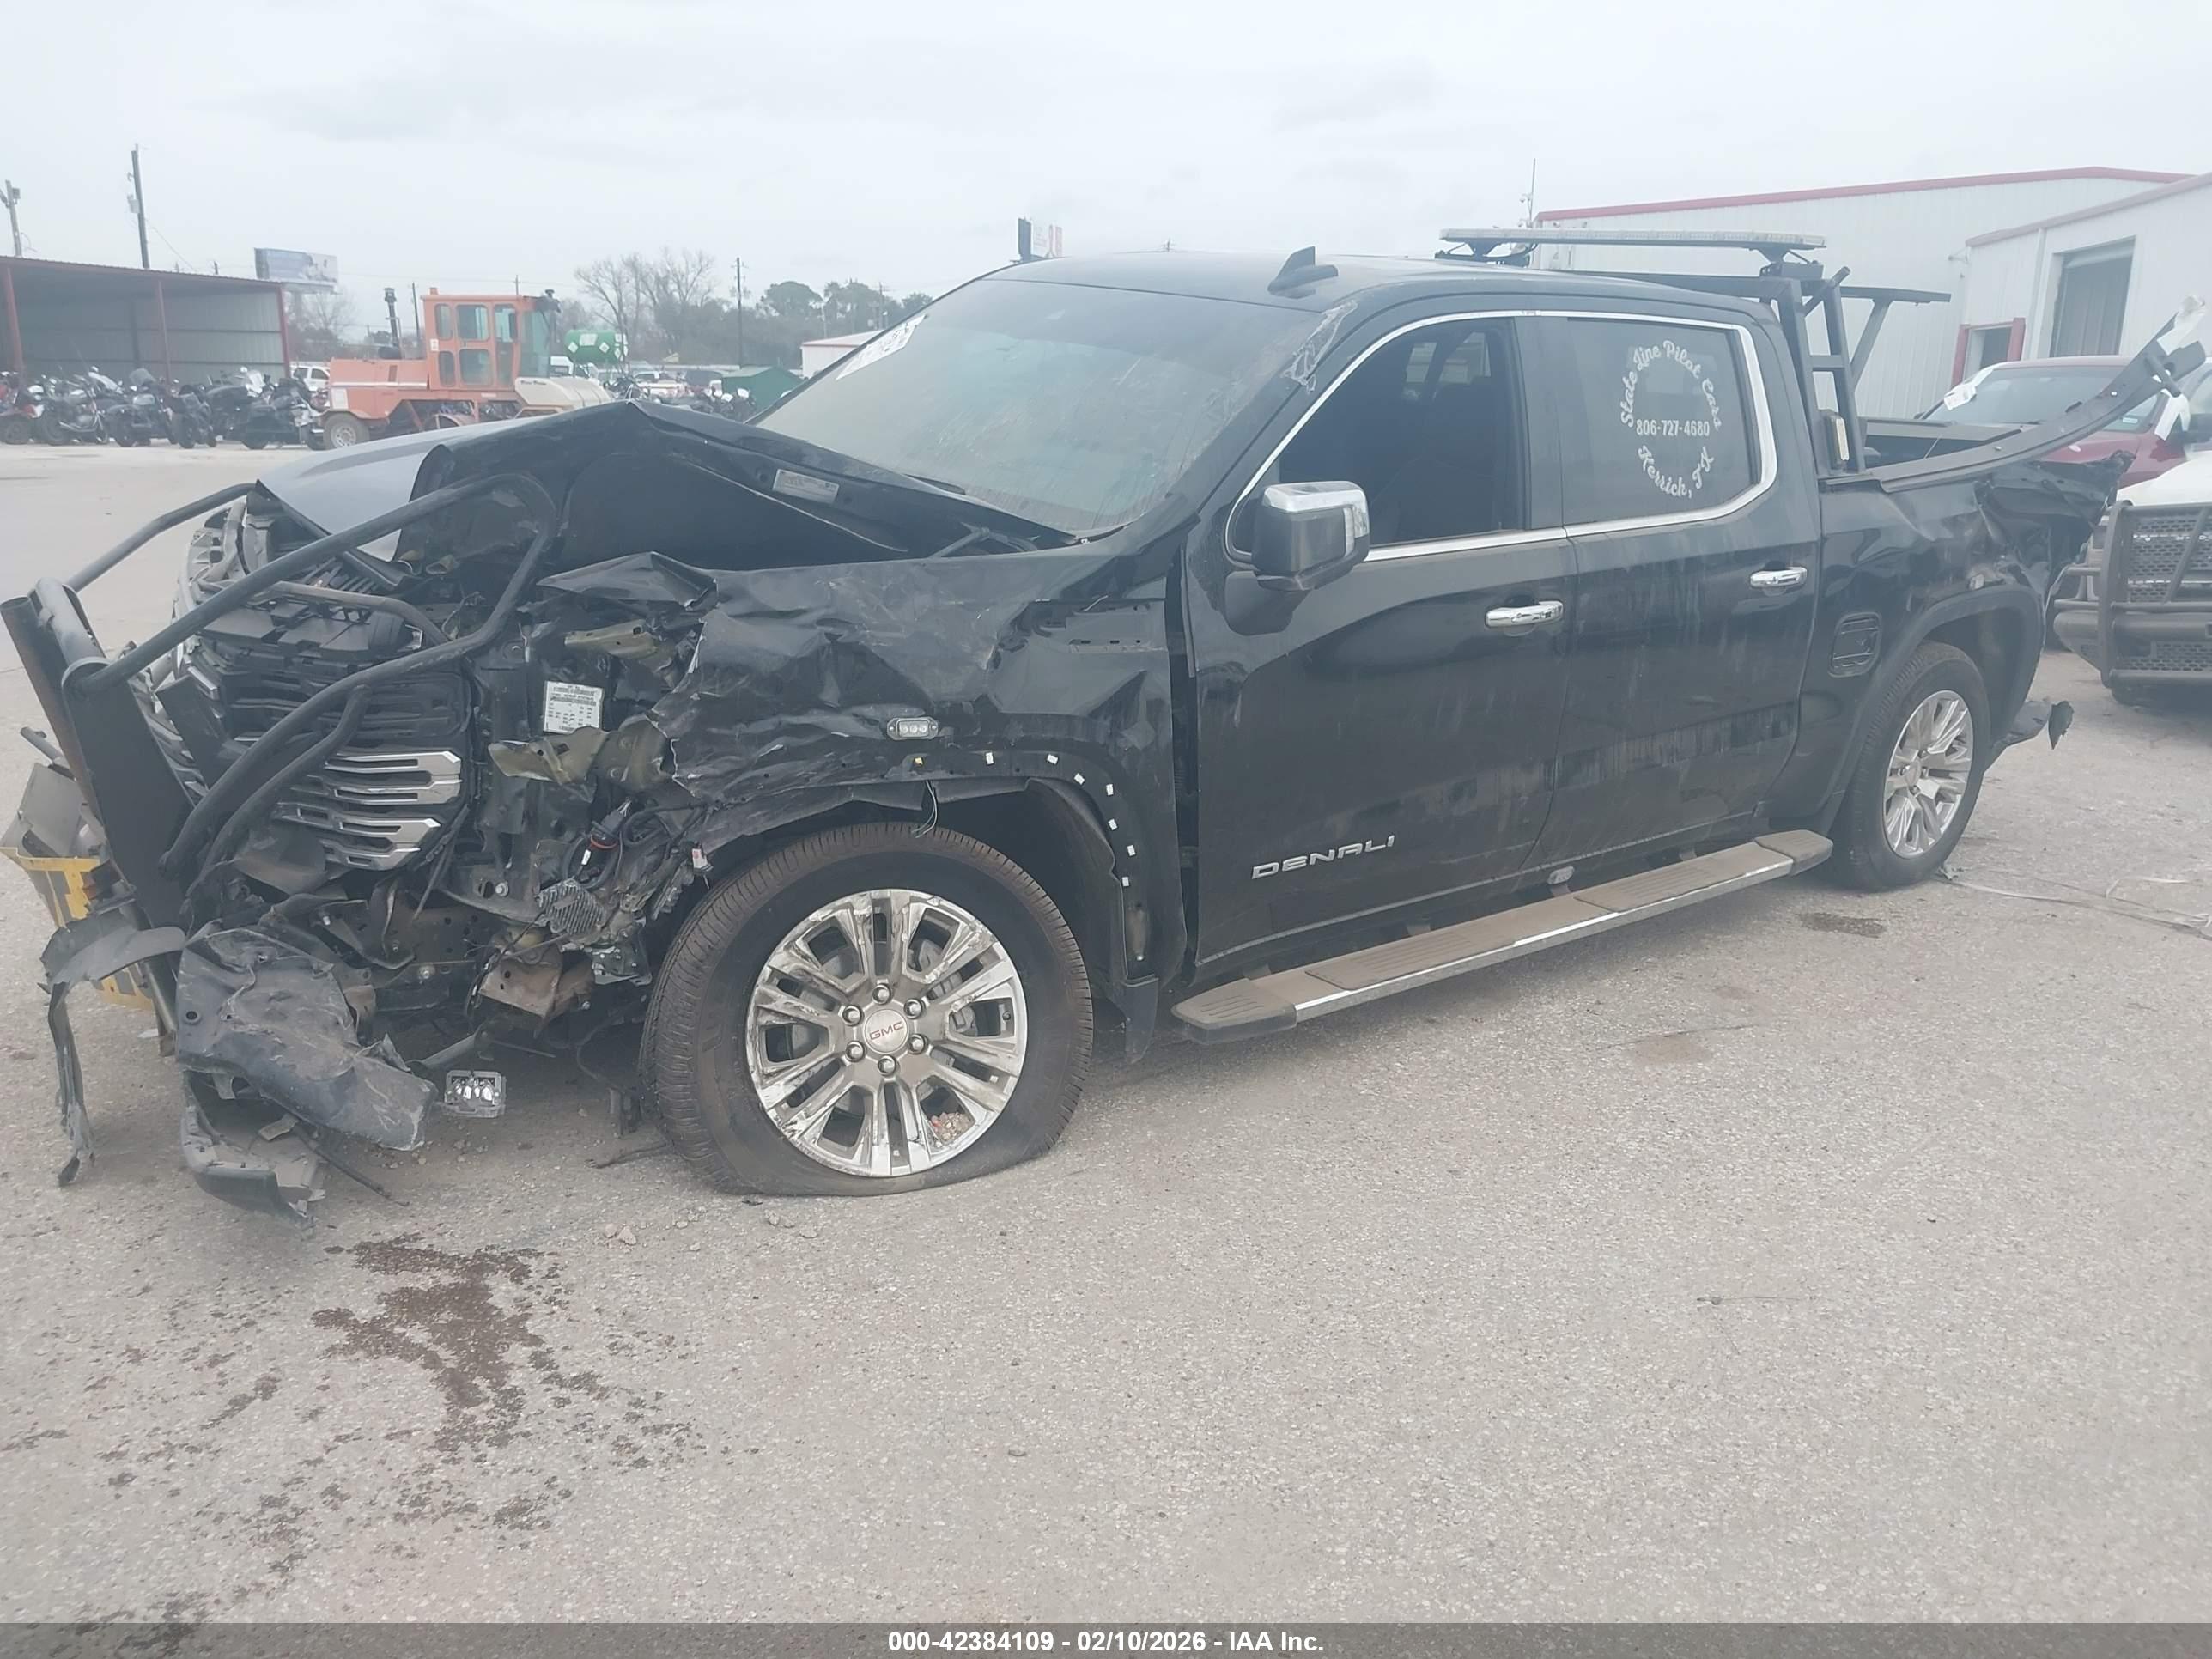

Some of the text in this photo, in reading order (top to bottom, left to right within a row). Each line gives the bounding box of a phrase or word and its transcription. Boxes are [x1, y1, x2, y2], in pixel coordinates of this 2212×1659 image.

[1620, 340, 1722, 431] State Line Pilot Cars
[1636, 418, 1710, 437] 806-727-4680
[1251, 835, 1395, 880] DENALI
[869, 1020, 904, 1041] GMC
